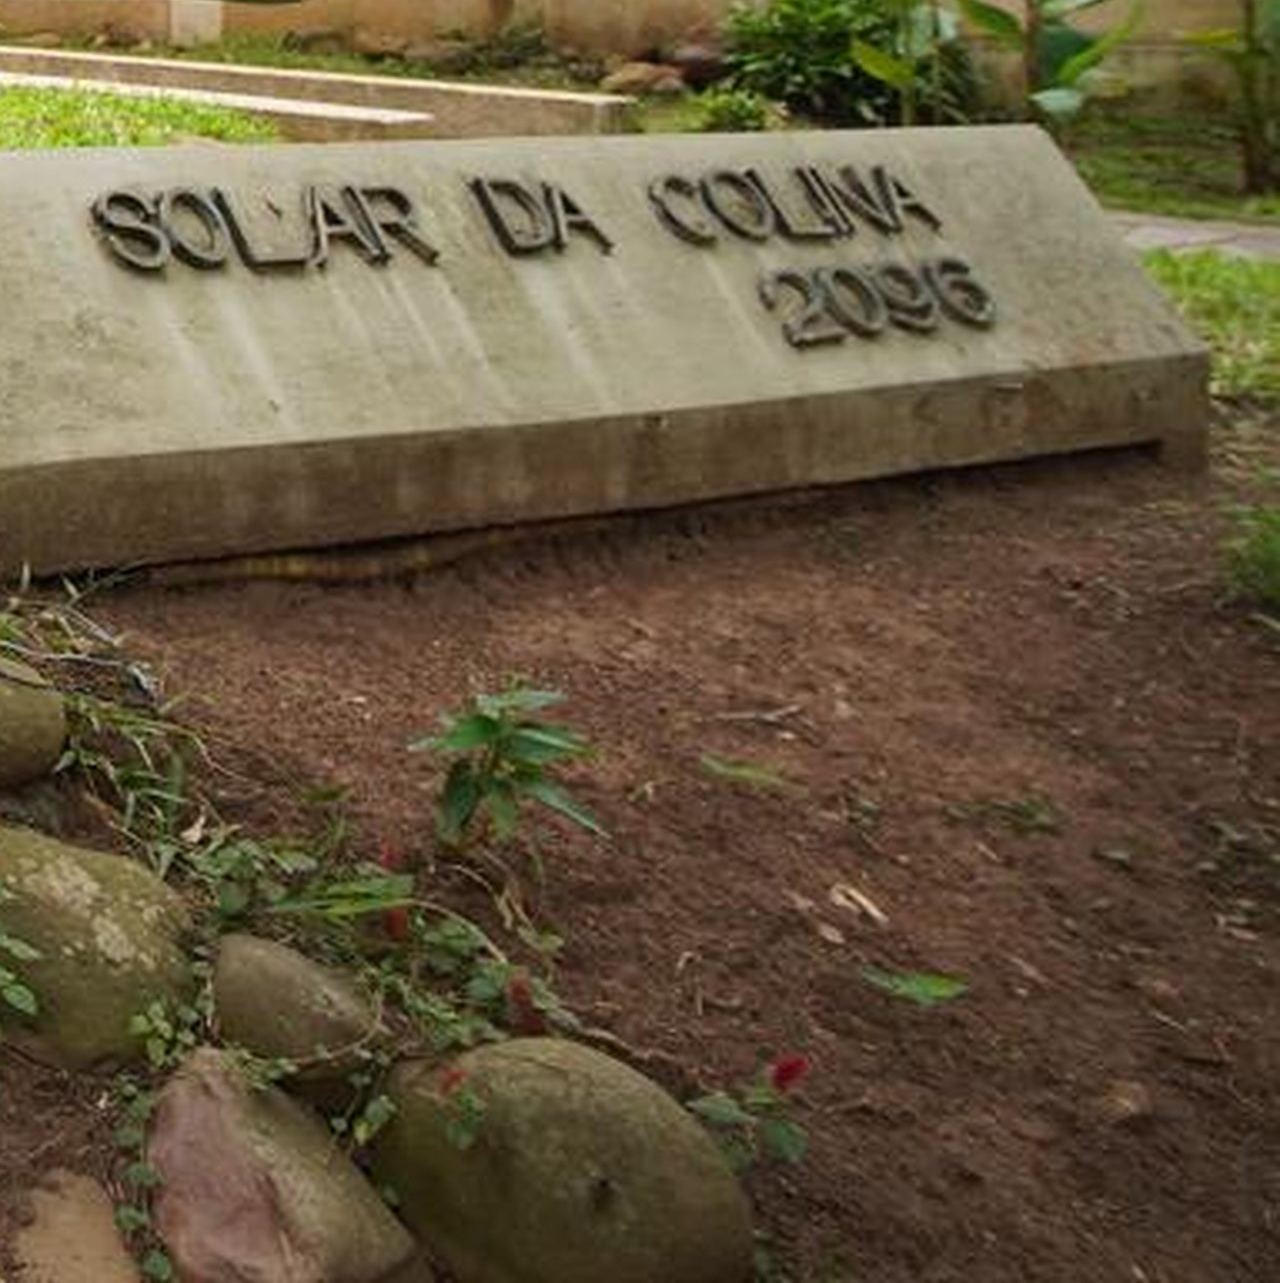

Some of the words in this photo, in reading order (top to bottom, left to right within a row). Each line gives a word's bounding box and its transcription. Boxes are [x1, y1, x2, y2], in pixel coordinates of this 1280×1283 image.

[91, 185, 439, 275] SOLAR
[467, 177, 619, 257] DA
[648, 166, 942, 247] COLINA
[758, 260, 996, 349] 2096
